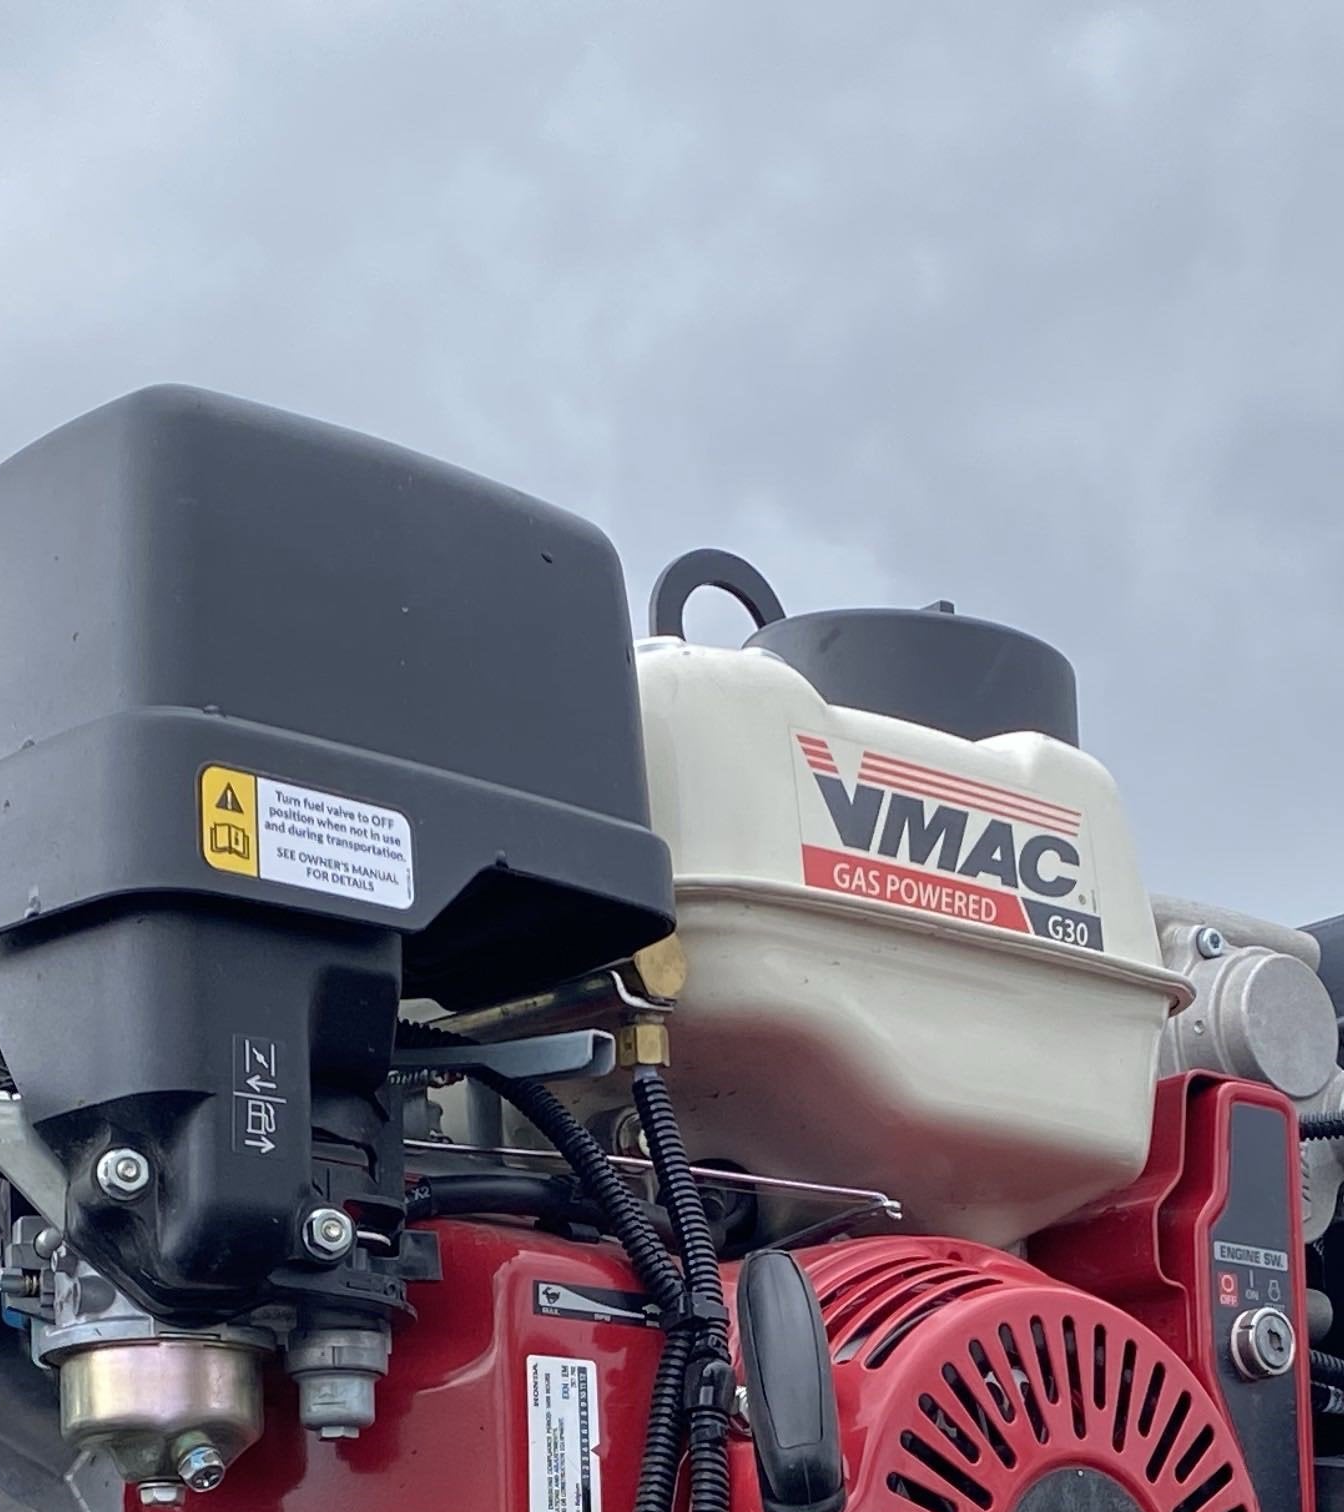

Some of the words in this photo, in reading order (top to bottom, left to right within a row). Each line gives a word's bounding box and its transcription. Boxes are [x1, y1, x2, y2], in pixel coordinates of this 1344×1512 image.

[269, 807, 314, 826] position
[318, 818, 346, 833] when
[350, 824, 368, 838] not
[370, 829, 380, 841] in
[383, 835, 401, 847] use
[275, 790, 300, 808] Turn
[304, 798, 324, 813] fuel
[327, 804, 354, 820] valve
[358, 812, 369, 823] to
[371, 815, 394, 830] OFF
[806, 757, 1081, 898] VMAC
[265, 819, 285, 833] and
[288, 824, 323, 844] during
[327, 833, 407, 862] transportation.
[277, 847, 296, 861] SEE
[298, 850, 349, 872] OWNER'S
[352, 863, 399, 885] MANUAL
[306, 868, 329, 881] FOR
[331, 872, 374, 892] DETAILS
[833, 862, 880, 895] GAS
[886, 873, 997, 922] POWERED
[1047, 915, 1088, 947] G30
[1220, 1245, 1261, 1264] ENGINE
[1264, 1253, 1284, 1268] SW.
[1220, 1294, 1237, 1306] OFF
[1245, 1289, 1259, 1300] ON
